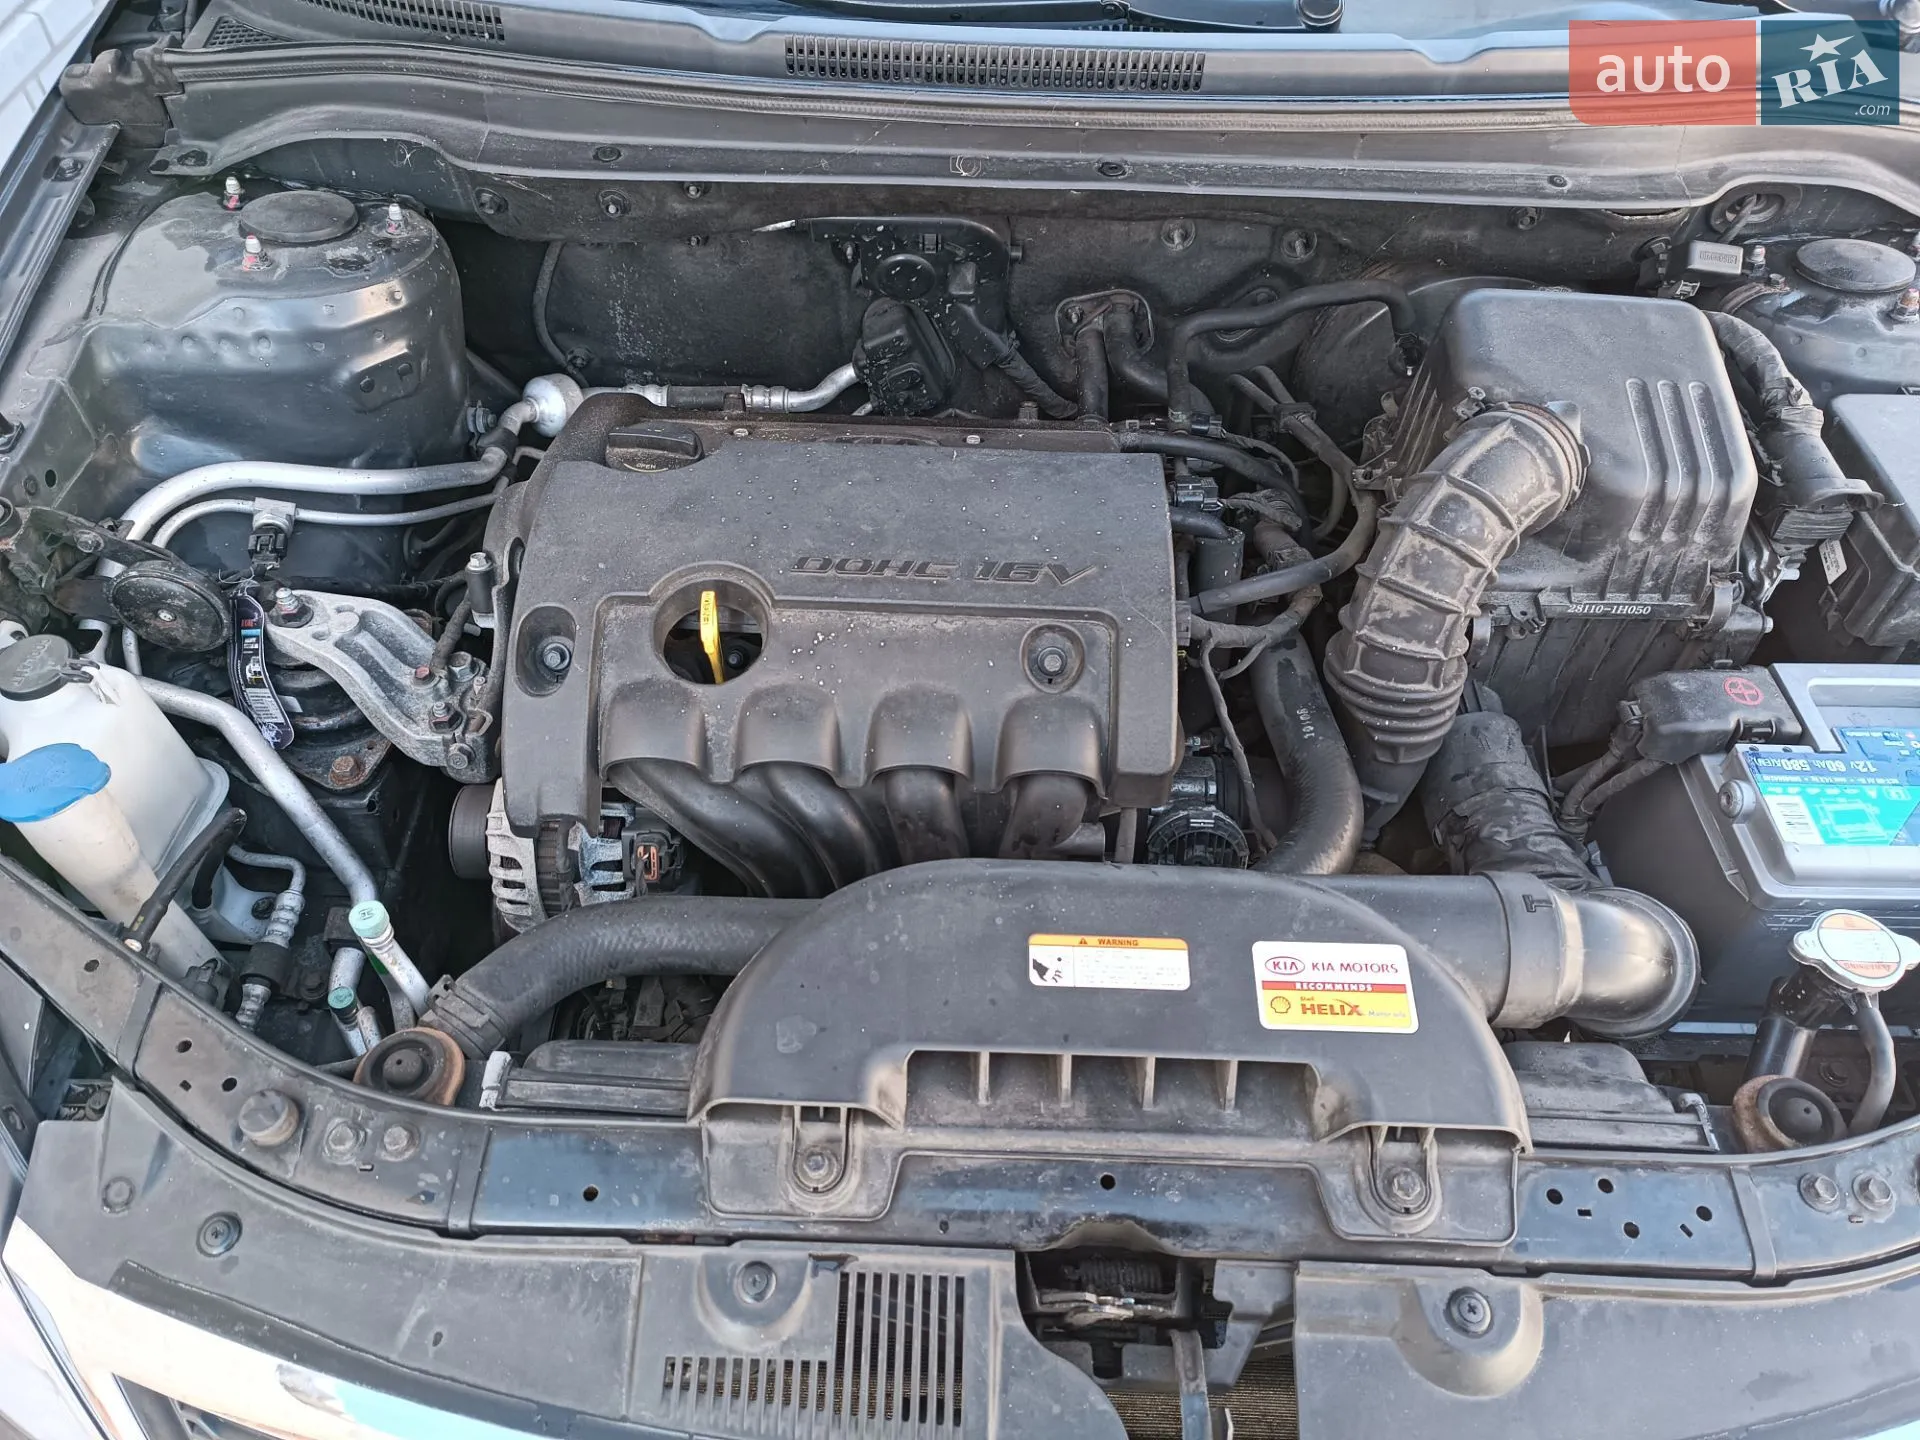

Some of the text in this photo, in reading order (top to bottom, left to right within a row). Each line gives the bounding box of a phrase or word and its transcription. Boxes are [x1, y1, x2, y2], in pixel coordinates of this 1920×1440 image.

[790, 556, 1098, 586] DOHC 16V
[1567, 604, 1652, 615] 28110-1H050
[1098, 938, 1140, 947] WARNING
[1272, 961, 1299, 971] KIA
[1311, 962, 1399, 974] KIA MOTORS
[1295, 981, 1373, 992] RECOMMENDS
[1300, 1003, 1363, 1016] HELIX
